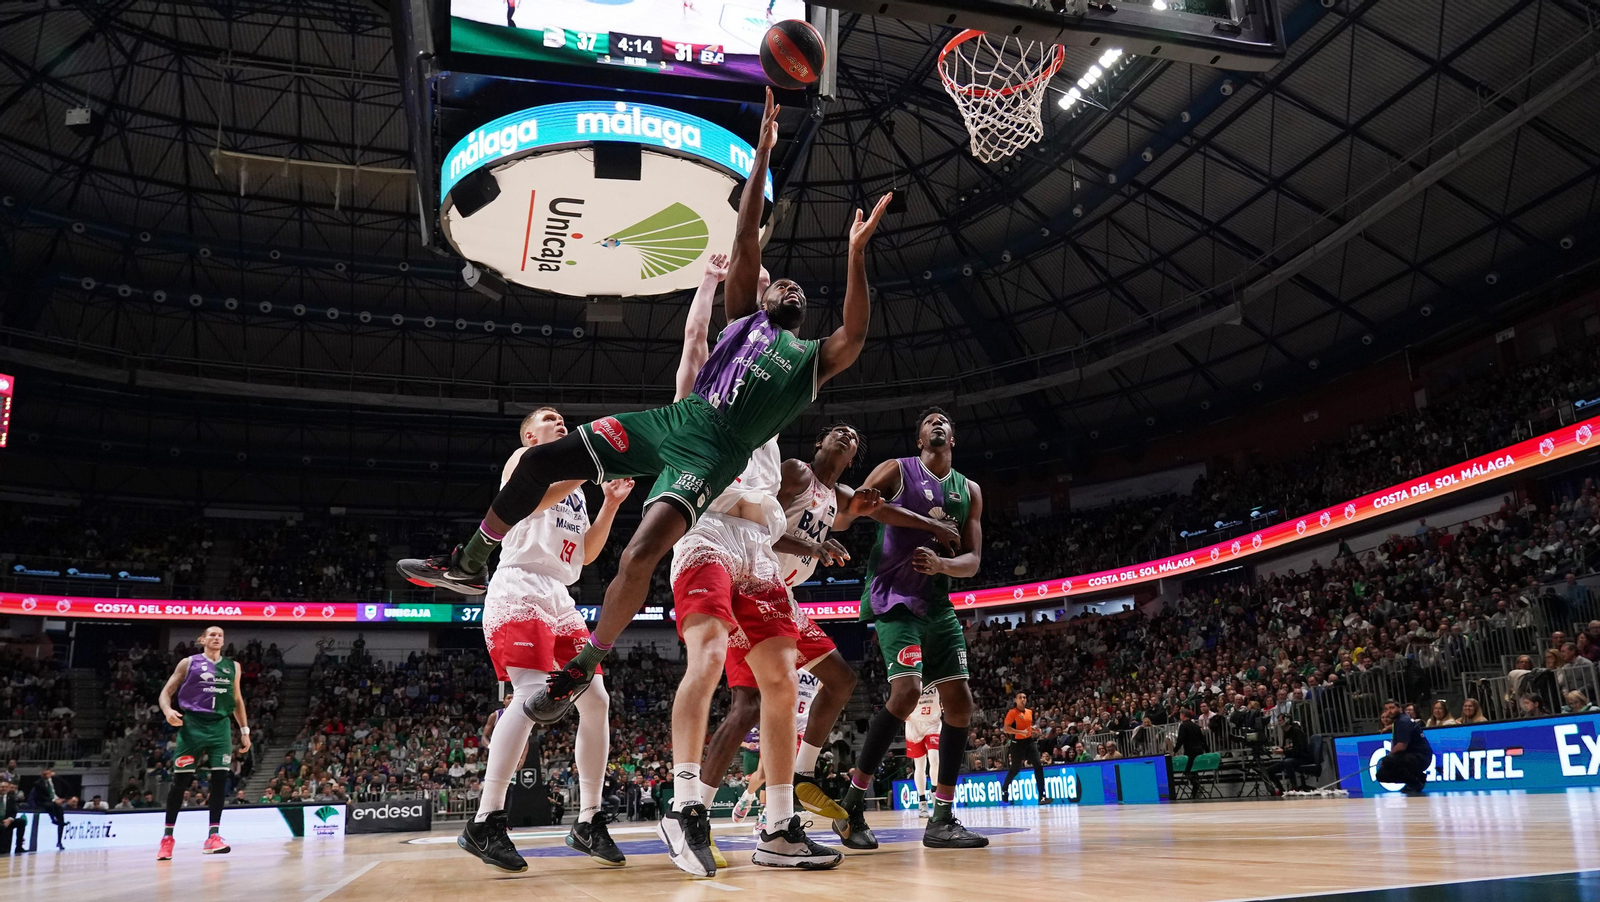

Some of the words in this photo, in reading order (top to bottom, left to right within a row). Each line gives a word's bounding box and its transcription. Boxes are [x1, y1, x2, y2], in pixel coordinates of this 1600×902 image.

[577, 32, 597, 51] 37
[618, 37, 653, 54] 4:14
[675, 43, 693, 62] 31
[577, 102, 702, 150] málaga
[450, 119, 538, 180] málaga
[530, 197, 585, 274] Unicaja
[1373, 490, 1409, 509] COSTA
[1411, 482, 1434, 498] DEL
[1435, 475, 1459, 490] SOL
[1461, 454, 1515, 481] MÁLAGA
[560, 539, 577, 565] 19
[1088, 573, 1119, 587] COSTA
[1120, 570, 1138, 582] DEL
[1139, 566, 1158, 577] SOL
[1158, 556, 1196, 573] MÁLAGA
[94, 603, 135, 614] COSTA
[138, 604, 162, 614] DEL
[165, 605, 189, 615] SOL
[192, 604, 242, 616] MÁLAGA
[383, 608, 432, 618] UNICAJA
[461, 607, 481, 621] 37
[817, 606, 836, 615] DEL
[837, 605, 857, 614] SOL
[211, 696, 216, 709] 1
[797, 701, 806, 714] 6
[921, 706, 932, 715] 23
[988, 778, 1001, 803] en
[352, 804, 423, 820] endesa
[712, 800, 735, 808] Unicaja
[64, 821, 77, 840] Por
[86, 820, 100, 839] Para
